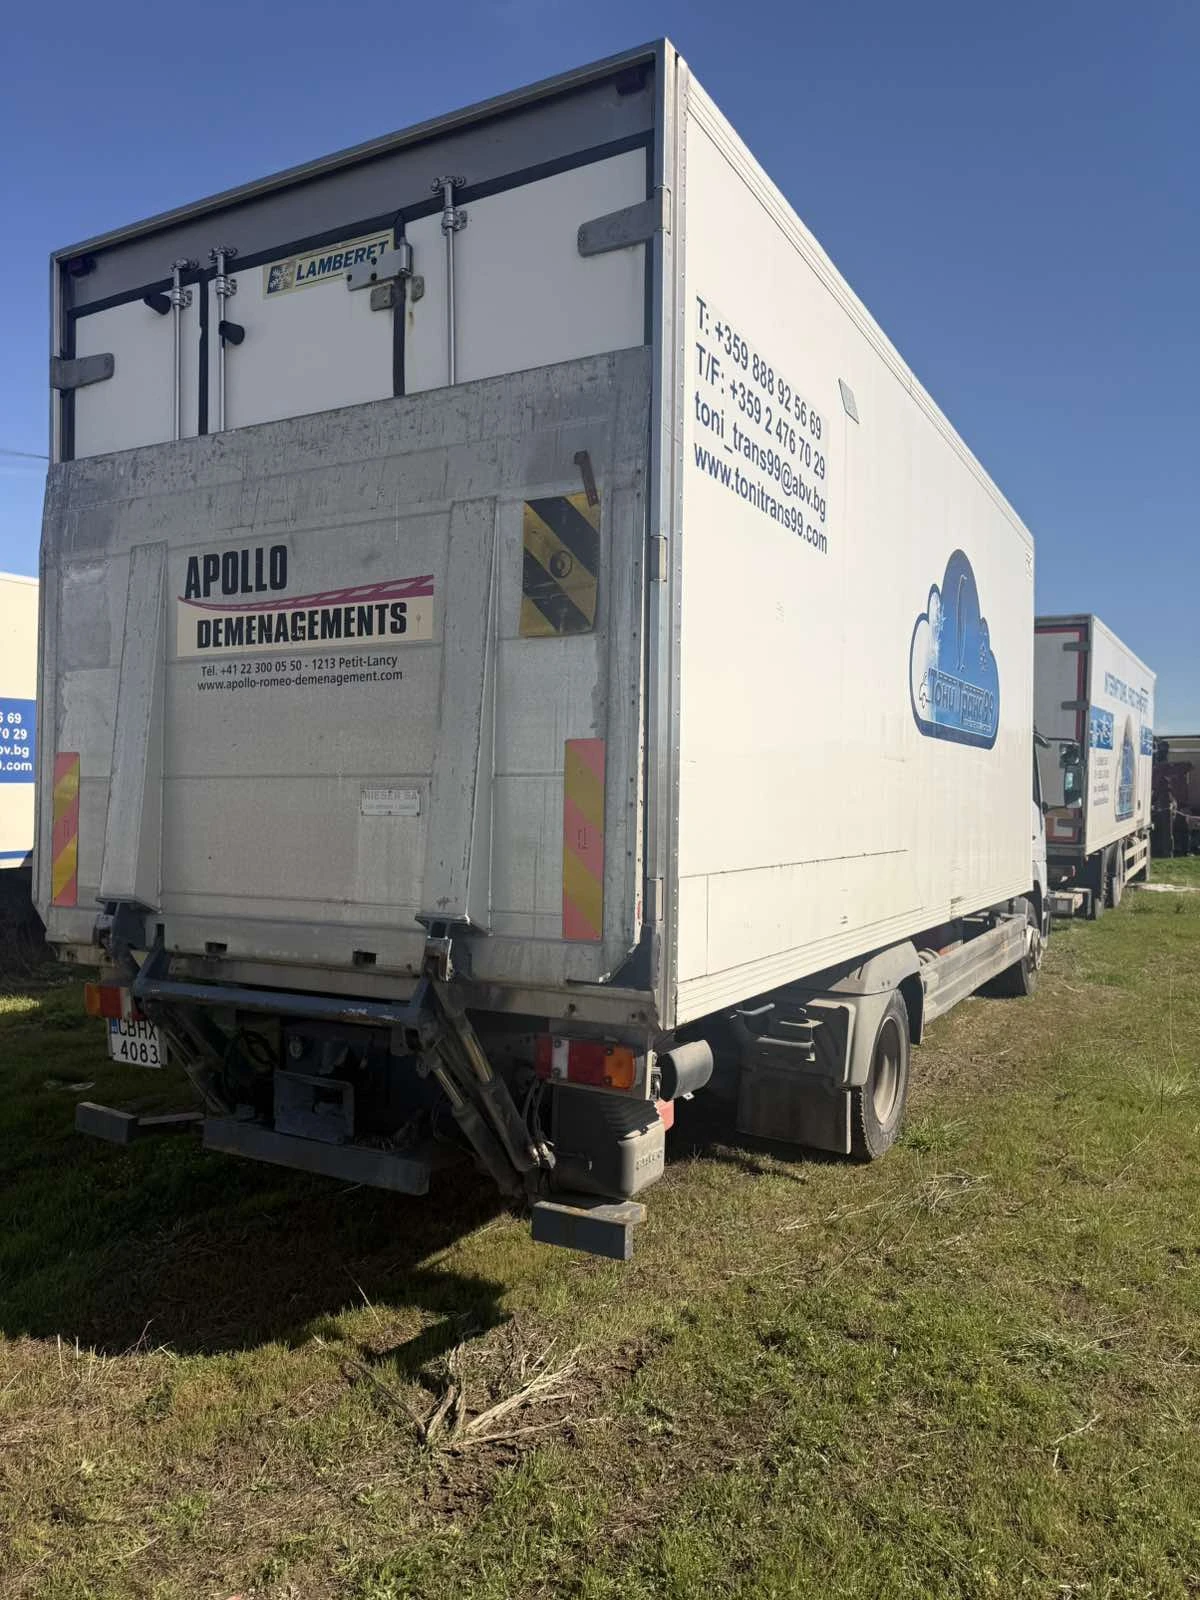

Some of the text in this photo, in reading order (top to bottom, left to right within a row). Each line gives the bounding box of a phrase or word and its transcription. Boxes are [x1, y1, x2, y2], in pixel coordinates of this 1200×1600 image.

[296, 240, 389, 281] LAMBERET
[696, 295, 821, 440] T: +359 888 92 56 69
[695, 342, 825, 480] T/F: +359 2 476 70 29
[694, 391, 826, 523] toni_trans99@abv.bg
[694, 443, 828, 554] www.tonitrans99.com
[185, 544, 288, 600] APOLLO
[197, 602, 408, 649] DEMENAGEMENTS
[197, 670, 403, 692] www.apollo-romeo-demenagement.com
[220, 664, 237, 676] +41
[240, 663, 251, 675] 22
[255, 662, 272, 674] 300
[275, 661, 287, 673] 05
[290, 660, 302, 672] 50
[312, 658, 336, 670] 1213
[339, 656, 398, 672] Petit-Lancy
[7, 712, 22, 724] 69
[13, 728, 28, 740] 29
[121, 1040, 158, 1064] 4083
